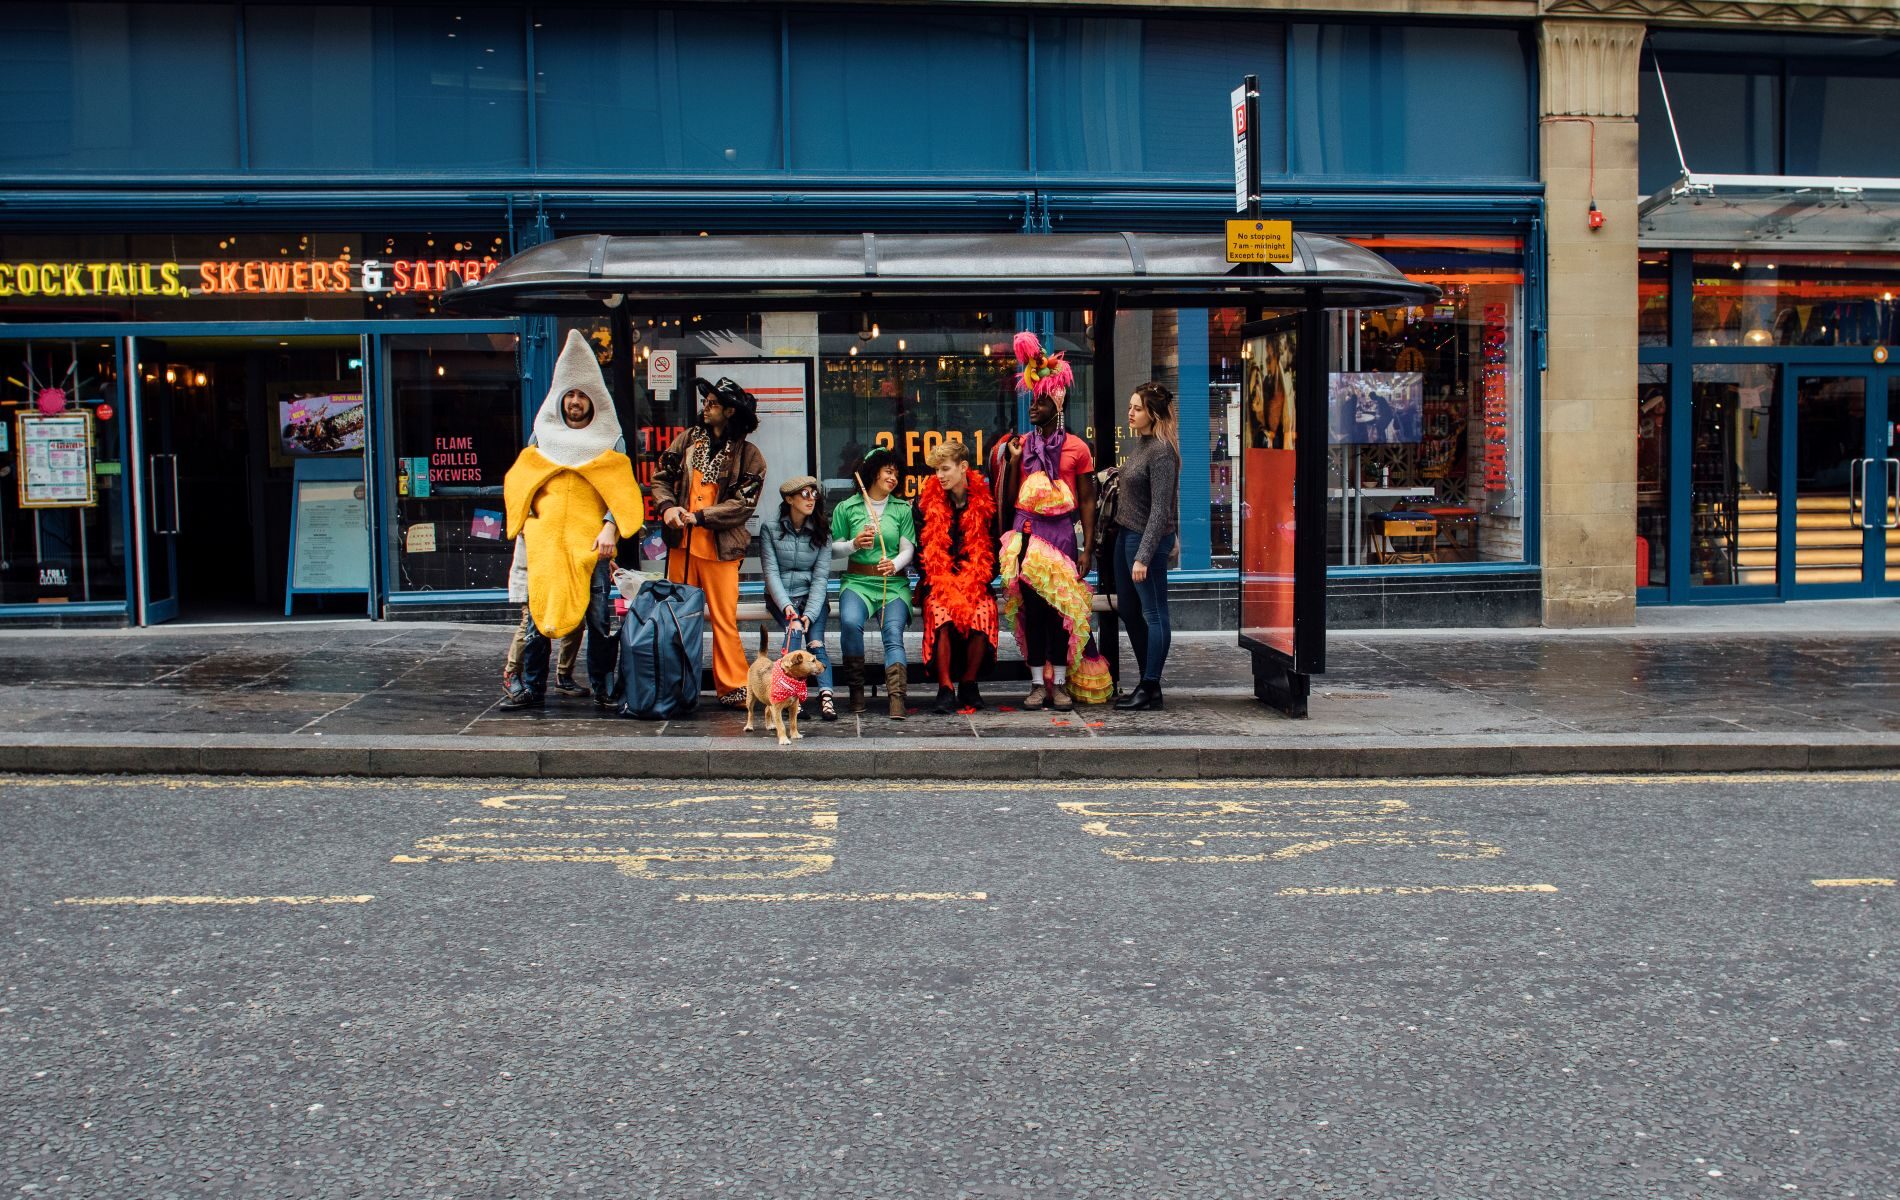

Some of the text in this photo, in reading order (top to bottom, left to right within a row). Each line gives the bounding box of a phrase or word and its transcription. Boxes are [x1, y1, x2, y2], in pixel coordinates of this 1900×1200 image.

[1237, 109, 1244, 131] B
[1250, 233, 1281, 241] stopping
[1254, 242, 1286, 250] midnight
[1229, 252, 1255, 260] Except
[0, 262, 190, 298] COCKTAILS,
[200, 261, 351, 293] SKEWERS
[361, 259, 383, 292] &
[435, 436, 474, 450] FLAME
[973, 429, 984, 466] 1
[431, 452, 479, 466] GRILLED
[429, 468, 482, 482] SKEWERS
